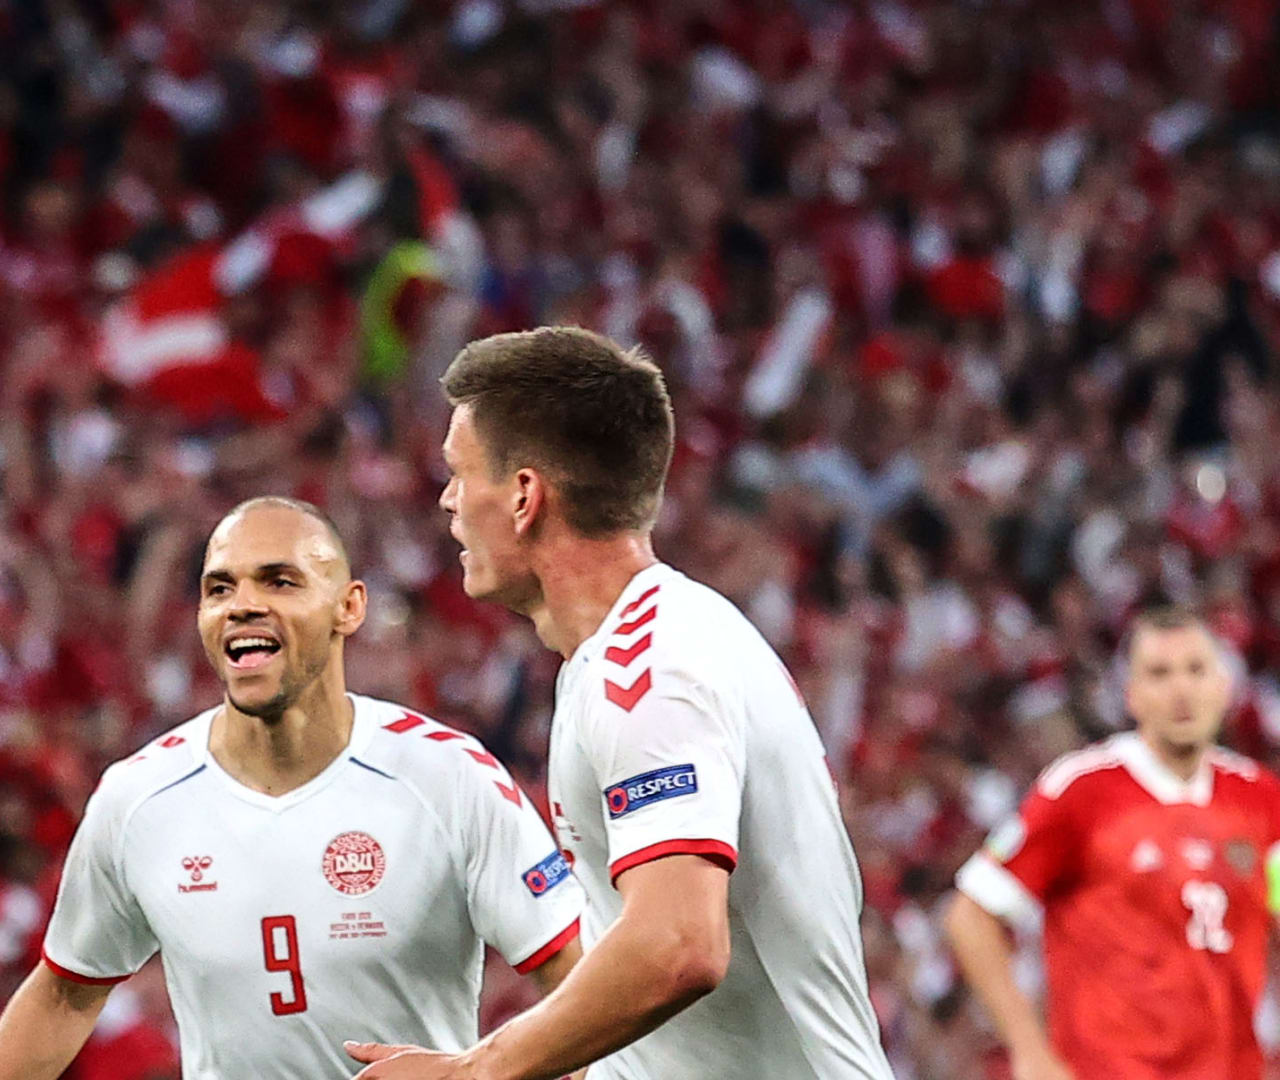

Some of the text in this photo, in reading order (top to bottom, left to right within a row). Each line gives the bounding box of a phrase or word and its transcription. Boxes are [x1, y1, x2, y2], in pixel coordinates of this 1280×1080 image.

[627, 771, 696, 802] RESPECT
[334, 852, 374, 873] DBU
[261, 915, 308, 1016] 9
